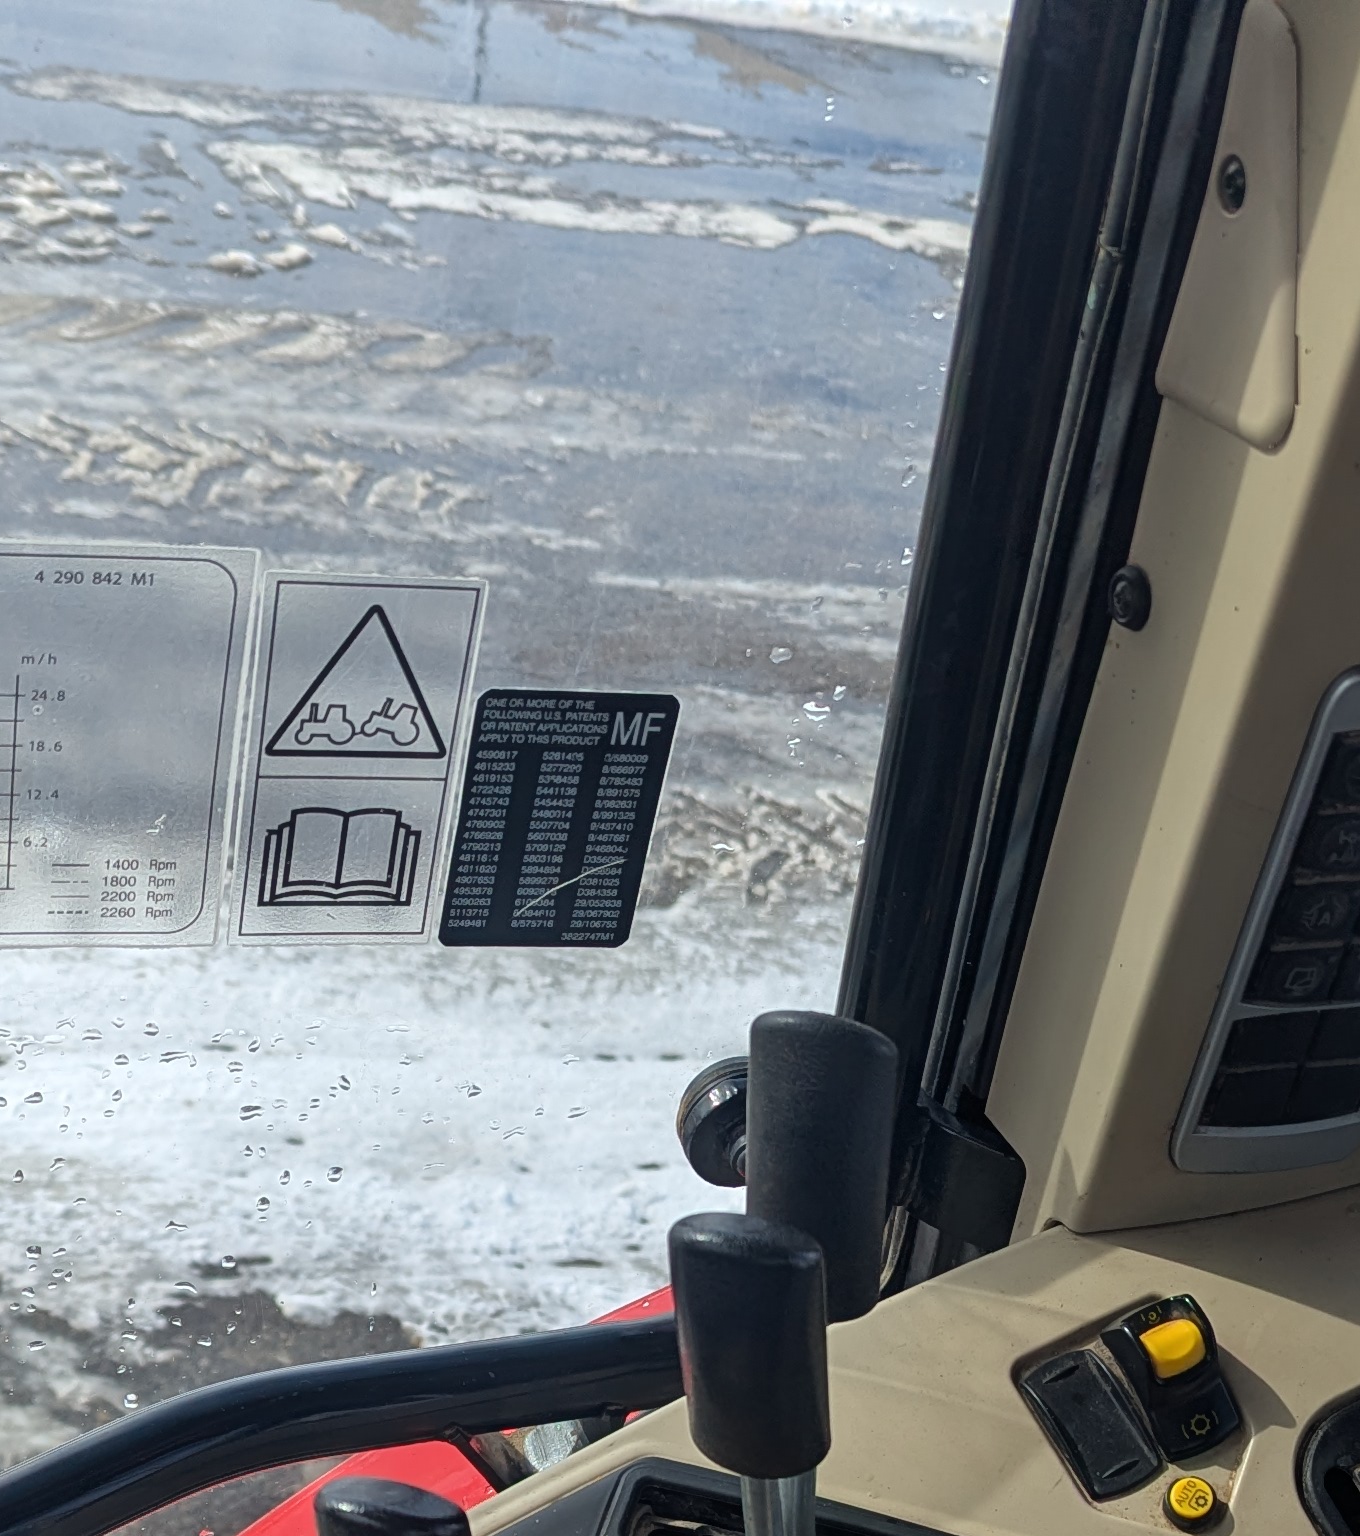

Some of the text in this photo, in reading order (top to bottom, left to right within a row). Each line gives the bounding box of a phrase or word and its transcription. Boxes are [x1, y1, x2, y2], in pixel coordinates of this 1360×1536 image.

[34, 571, 154, 586] 4 290 842 M1
[31, 690, 66, 701] 24.8
[486, 698, 595, 709] ONE OR MORE OF THE
[483, 710, 609, 722] FOLLOWING U.S. PATENTS
[481, 722, 608, 733] OR PATENT APPLICATIONS
[610, 712, 666, 746] MF
[478, 734, 600, 745] APPLY TO THIS PRODUCT
[29, 741, 63, 752] 18.6
[27, 790, 59, 800] 12.4
[105, 859, 176, 873] 1400 Rpm
[102, 876, 175, 889] 1800 Rpm
[101, 891, 174, 904] 2200 Rpm
[101, 908, 172, 920] 2260 Rpm
[1175, 1480, 1196, 1507] AUTO
